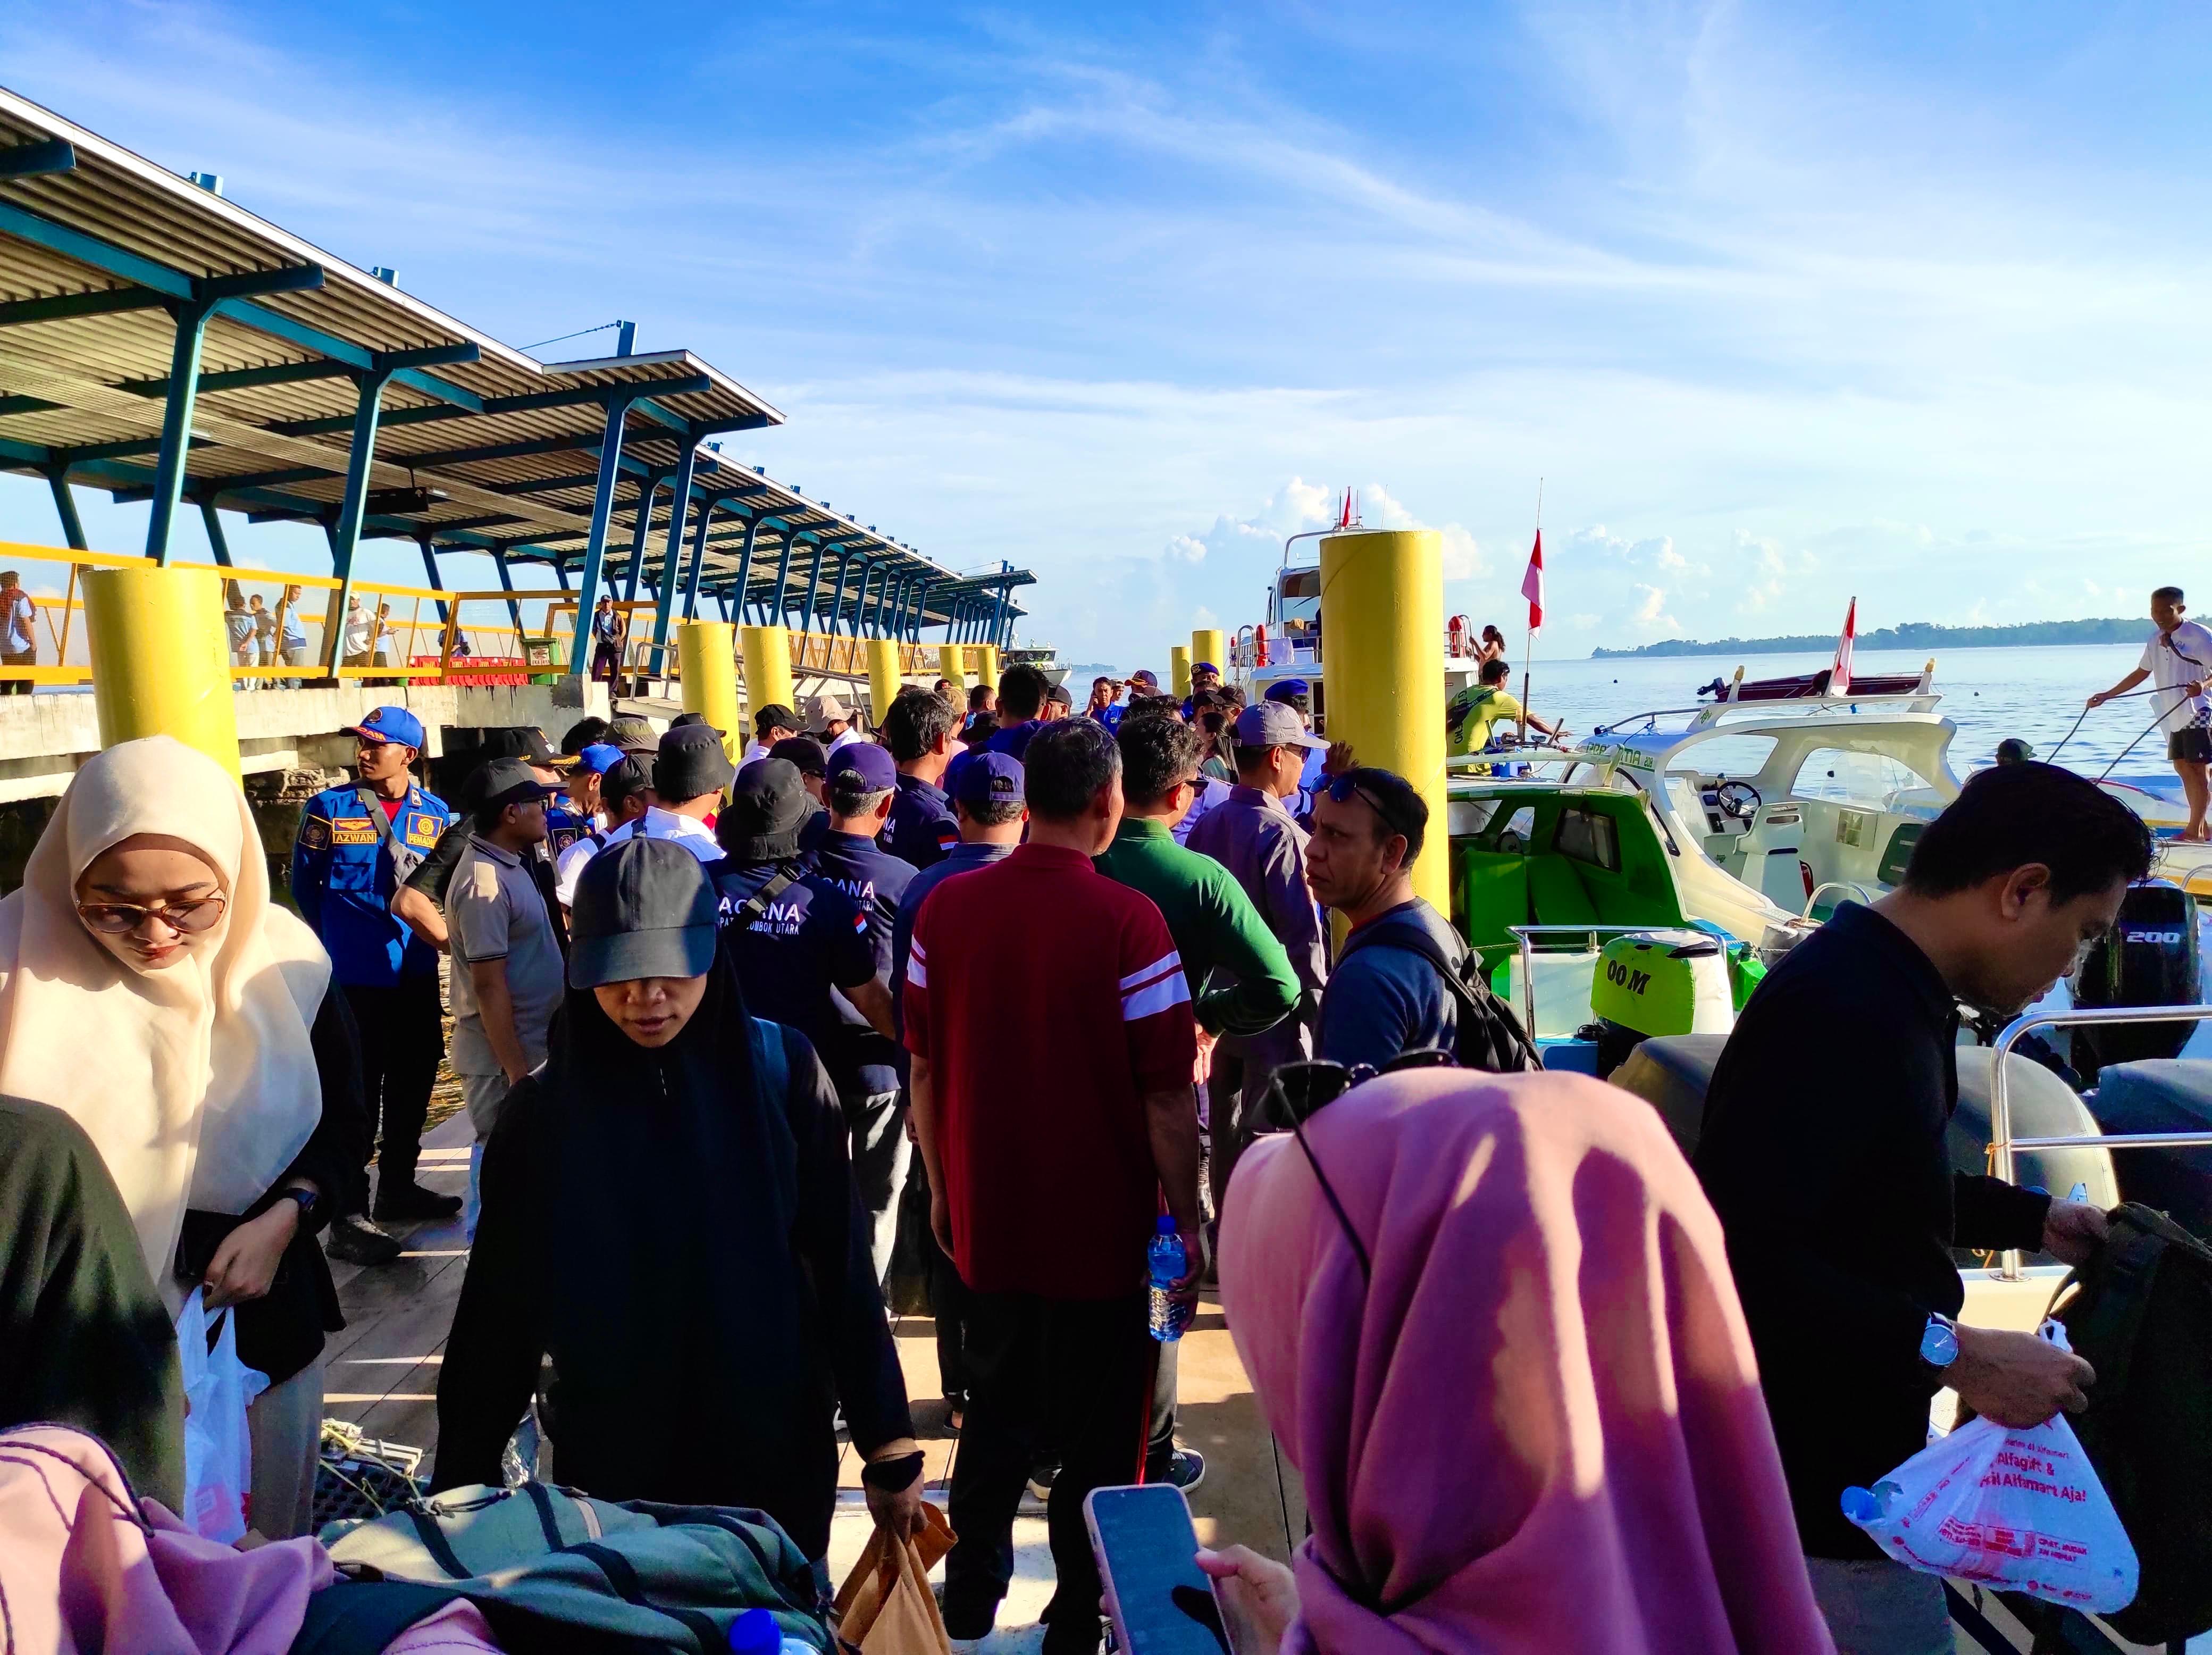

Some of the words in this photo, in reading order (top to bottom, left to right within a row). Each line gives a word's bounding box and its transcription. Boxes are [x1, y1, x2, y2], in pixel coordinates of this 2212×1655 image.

[1586, 741, 1641, 765] PRAMA
[747, 920, 773, 934] OMBOK
[776, 923, 800, 935] UTARA
[2126, 931, 2181, 944] 200
[1997, 1452, 2042, 1472] Alfagift
[2046, 1462, 2055, 1476] &
[2003, 1473, 2058, 1497] Alfamart
[2060, 1485, 2087, 1503] Aja!
